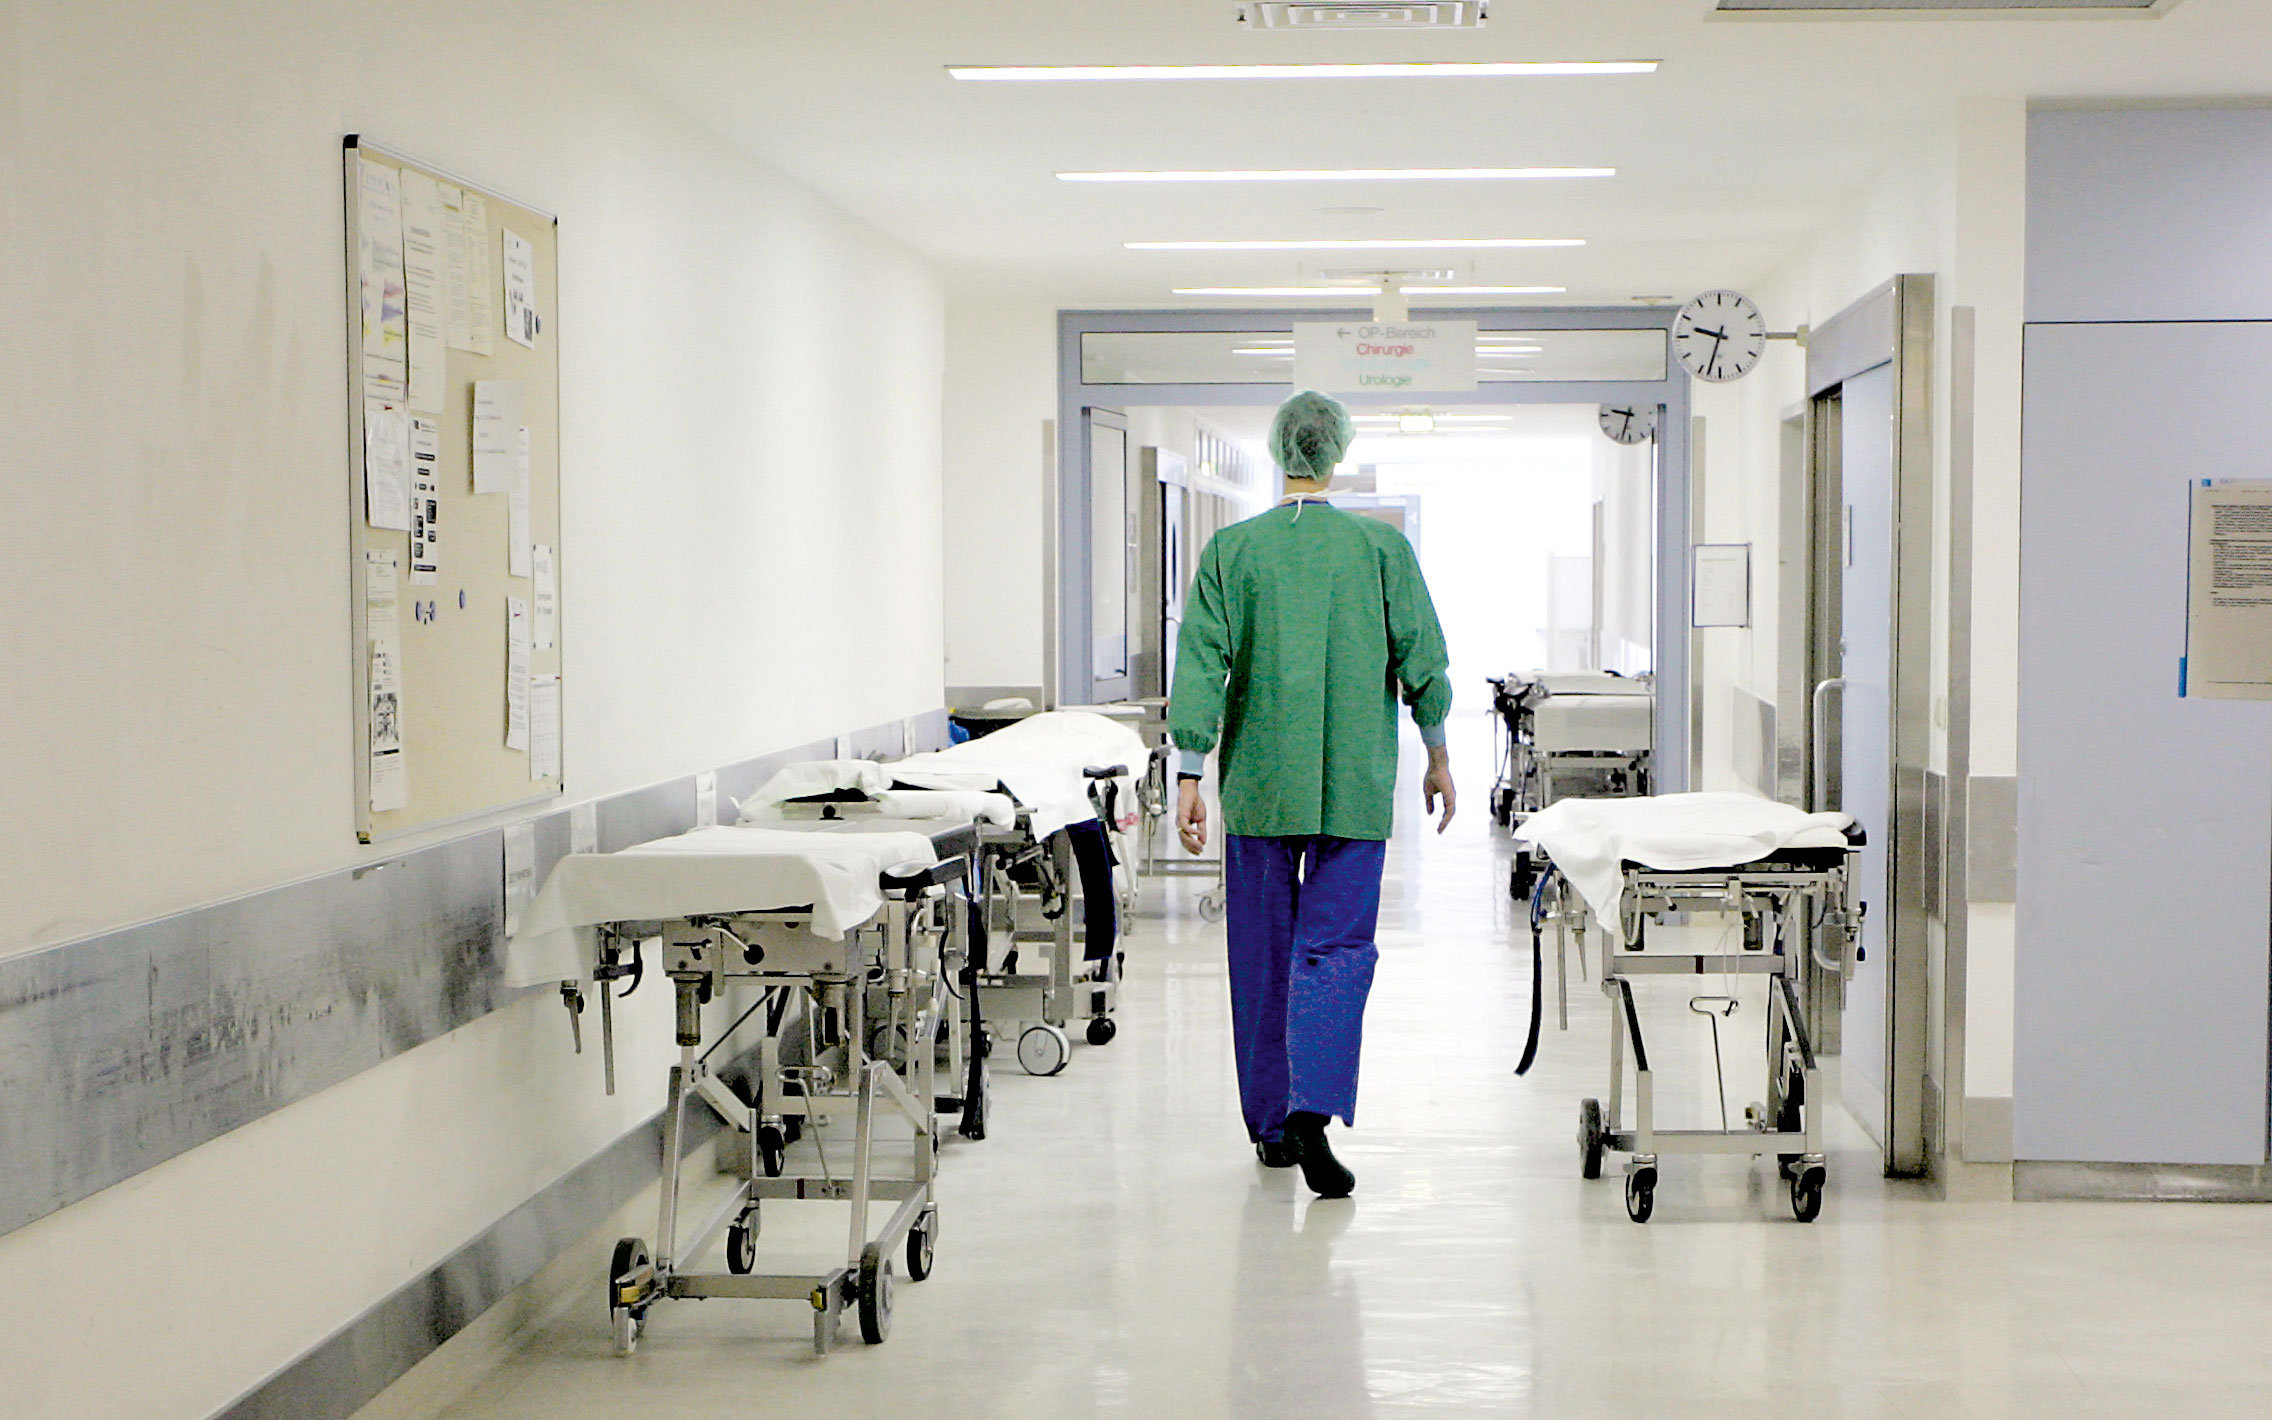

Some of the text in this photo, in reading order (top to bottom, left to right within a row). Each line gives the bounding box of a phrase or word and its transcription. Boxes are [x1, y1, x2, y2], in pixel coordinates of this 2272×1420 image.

[1358, 326, 1436, 339] OP-Bereich
[1356, 343, 1414, 358] Chirurgie
[1359, 374, 1412, 388] Urologie
